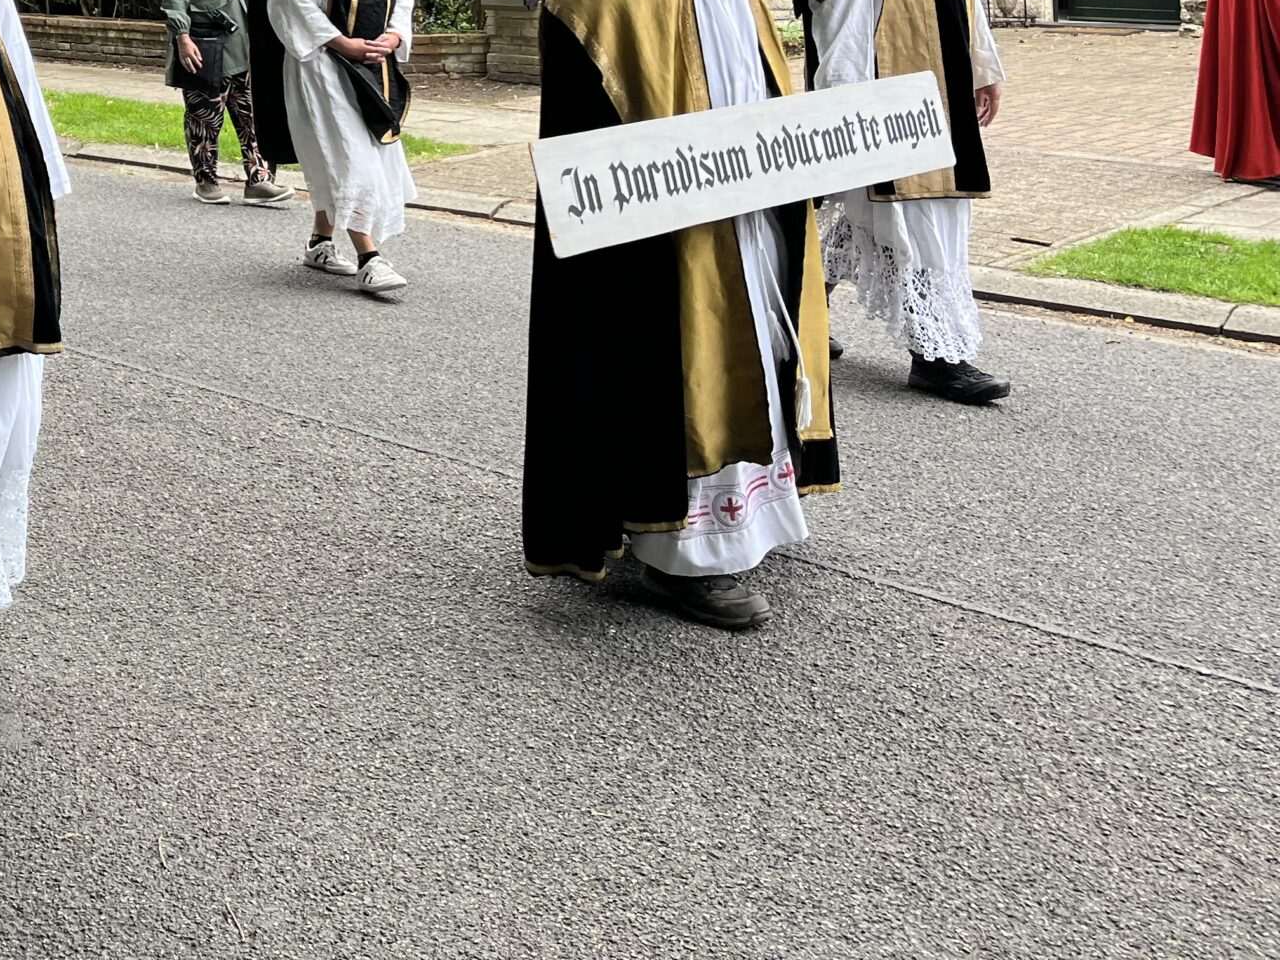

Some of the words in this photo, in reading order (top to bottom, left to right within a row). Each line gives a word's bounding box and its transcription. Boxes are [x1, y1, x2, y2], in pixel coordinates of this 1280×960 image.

[560, 166, 603, 225] In
[608, 144, 753, 215] Paradisum
[755, 114, 858, 175] dedúcant
[855, 111, 882, 153] te
[883, 97, 942, 150] angeli
